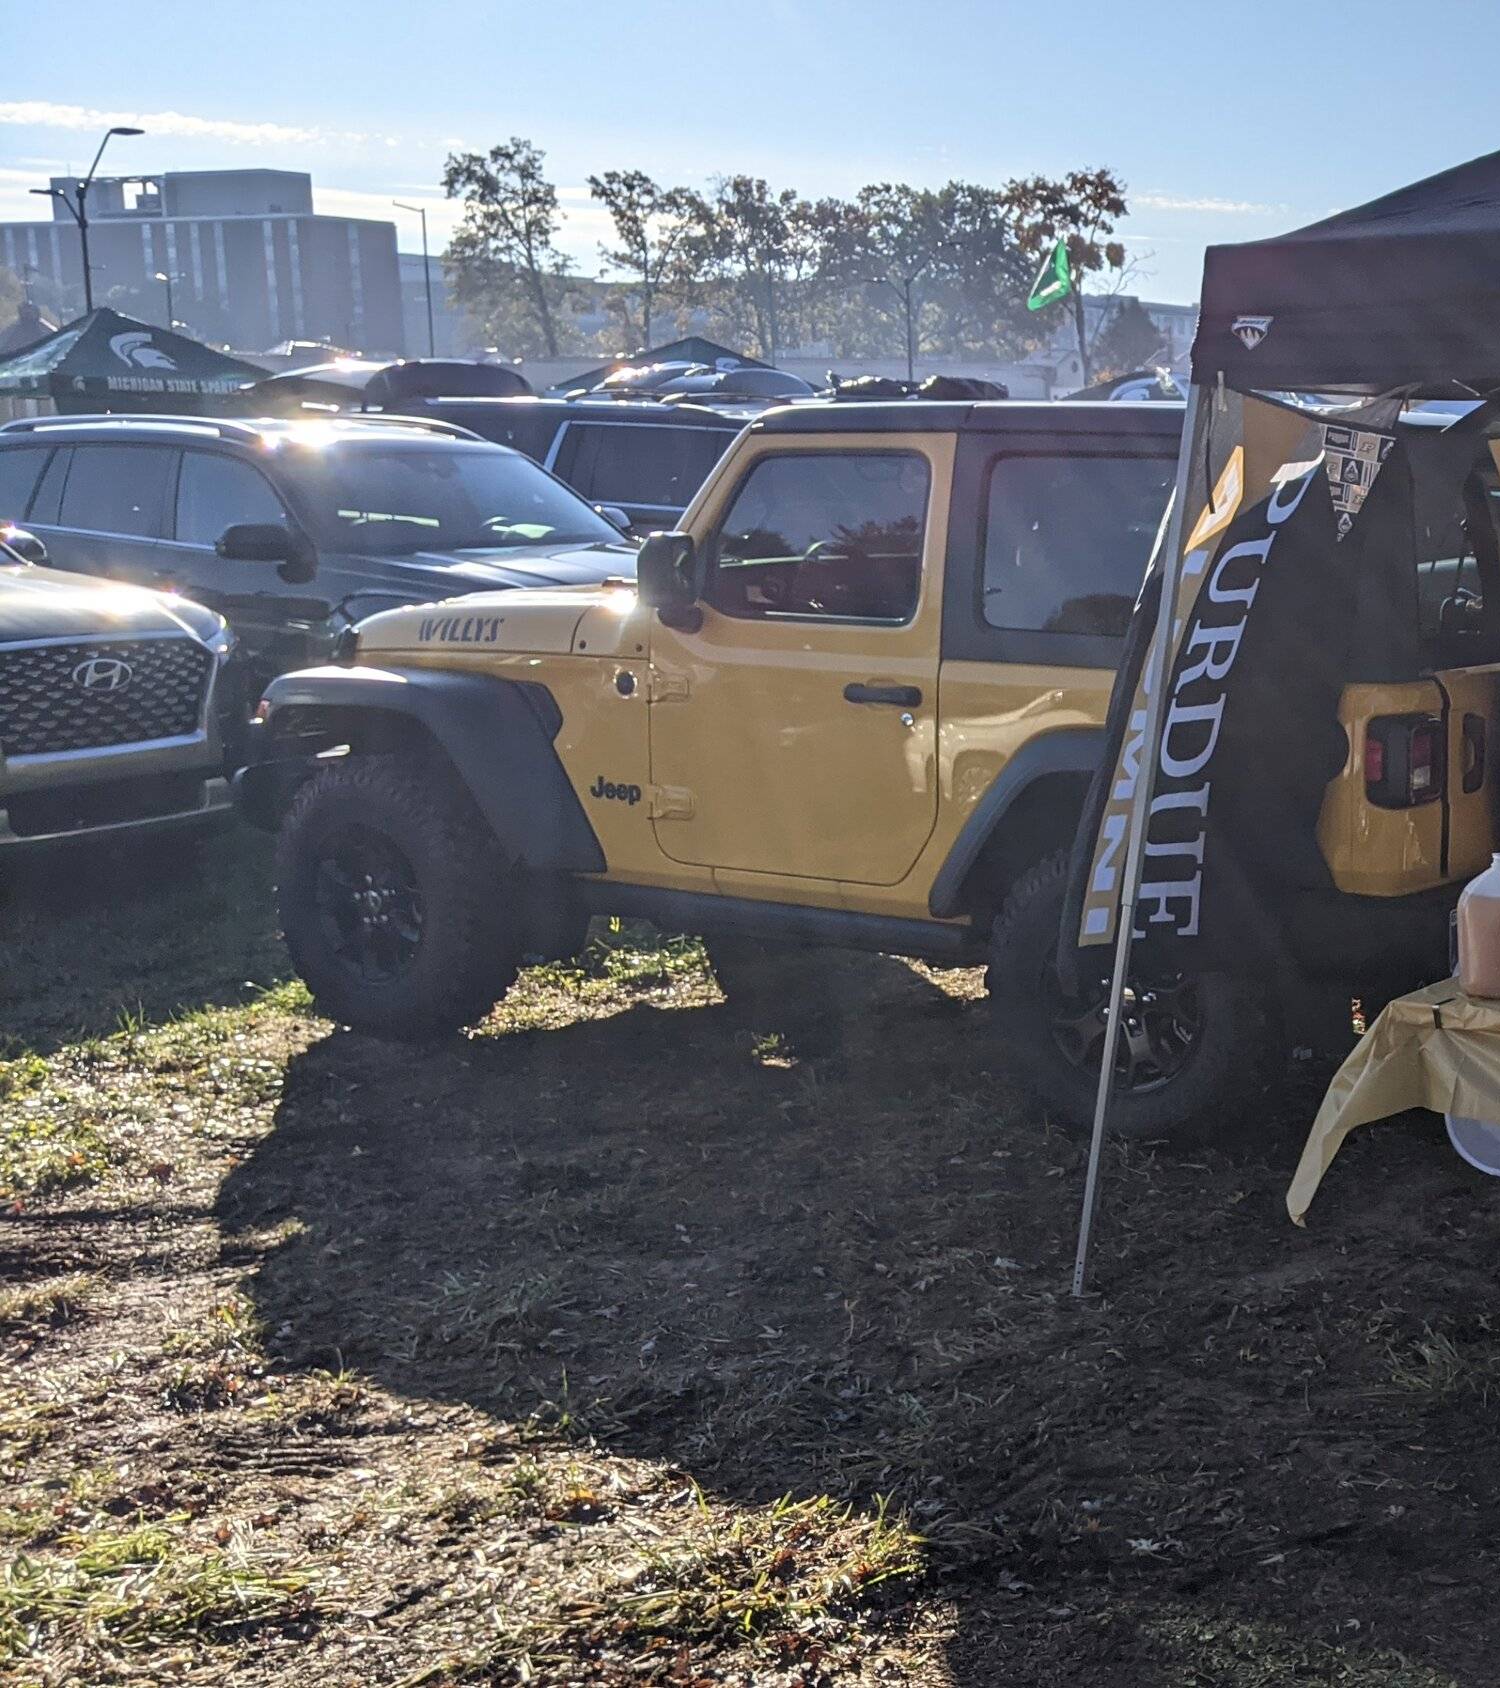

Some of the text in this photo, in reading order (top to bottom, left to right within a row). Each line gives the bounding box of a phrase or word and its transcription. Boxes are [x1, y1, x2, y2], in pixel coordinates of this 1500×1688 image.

[107, 376, 164, 393] MICHIGAN
[167, 379, 199, 393] STATE
[419, 617, 505, 643] WILLYS
[1132, 449, 1326, 939] PURDUE
[590, 775, 642, 805] Jeep
